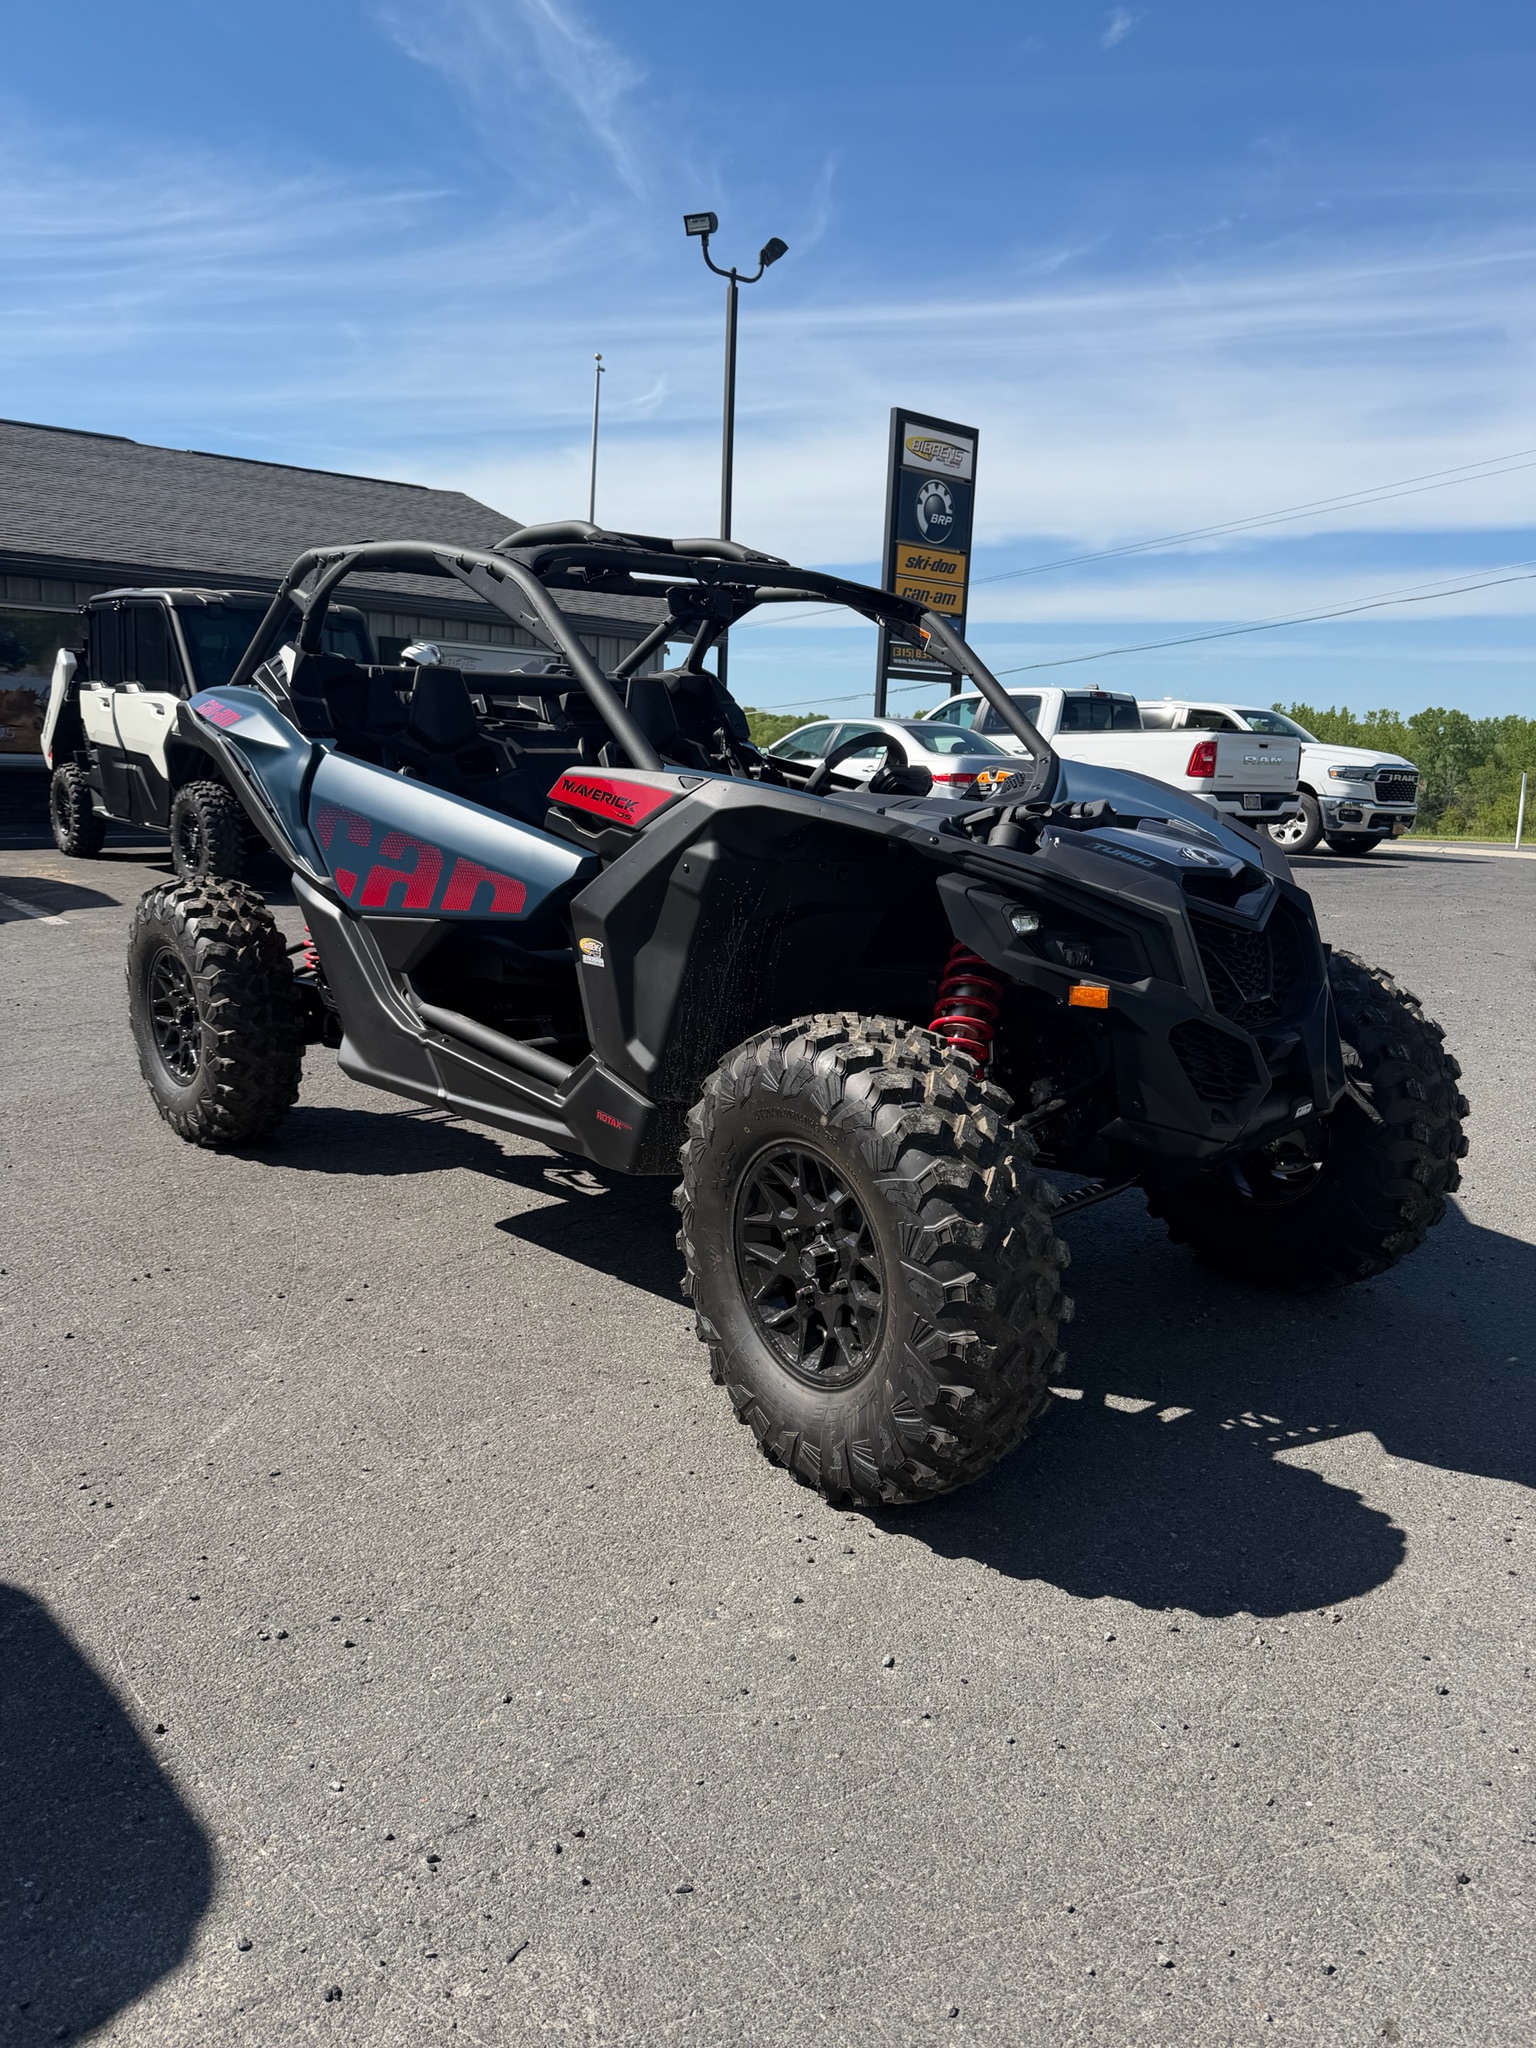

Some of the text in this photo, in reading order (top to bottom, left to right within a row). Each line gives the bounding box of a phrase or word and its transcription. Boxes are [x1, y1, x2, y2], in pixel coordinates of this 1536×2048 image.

[912, 440, 964, 462] BIBBENS
[931, 513, 953, 526] BRP
[905, 555, 957, 574] ski-doo
[902, 587, 957, 606] can-am
[195, 699, 241, 728] can-am
[1243, 755, 1282, 766] RAM
[1393, 774, 1415, 782] RAM
[562, 779, 639, 812] MAVERICK
[1093, 842, 1156, 867] TURBO
[596, 1111, 622, 1130] ROTAX
